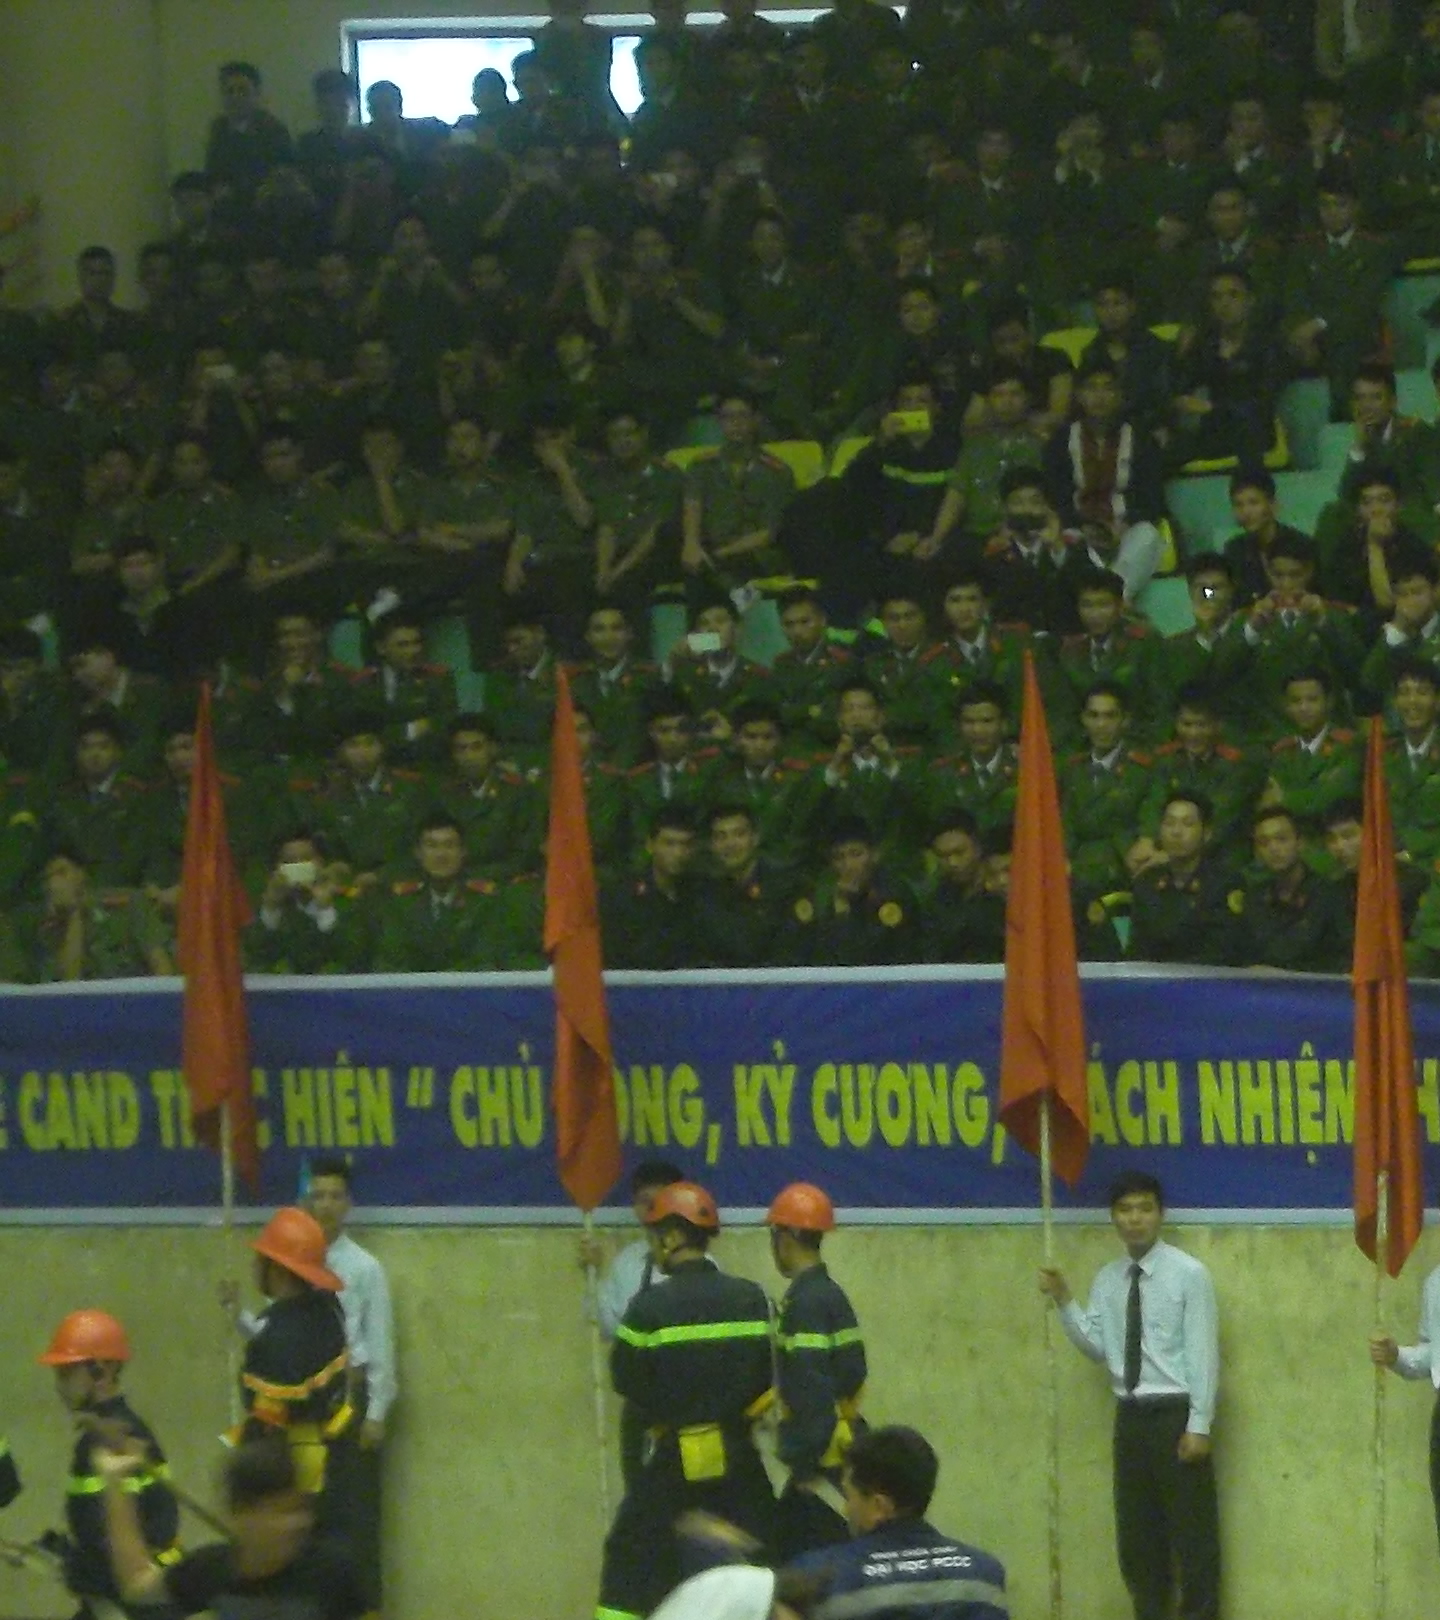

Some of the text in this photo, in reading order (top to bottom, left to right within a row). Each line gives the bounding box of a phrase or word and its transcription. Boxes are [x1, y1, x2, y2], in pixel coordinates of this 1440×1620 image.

[18, 1070, 141, 1150] CAND
[450, 1042, 545, 1148] CHỦ
[1086, 1042, 1182, 1147] ÁCH
